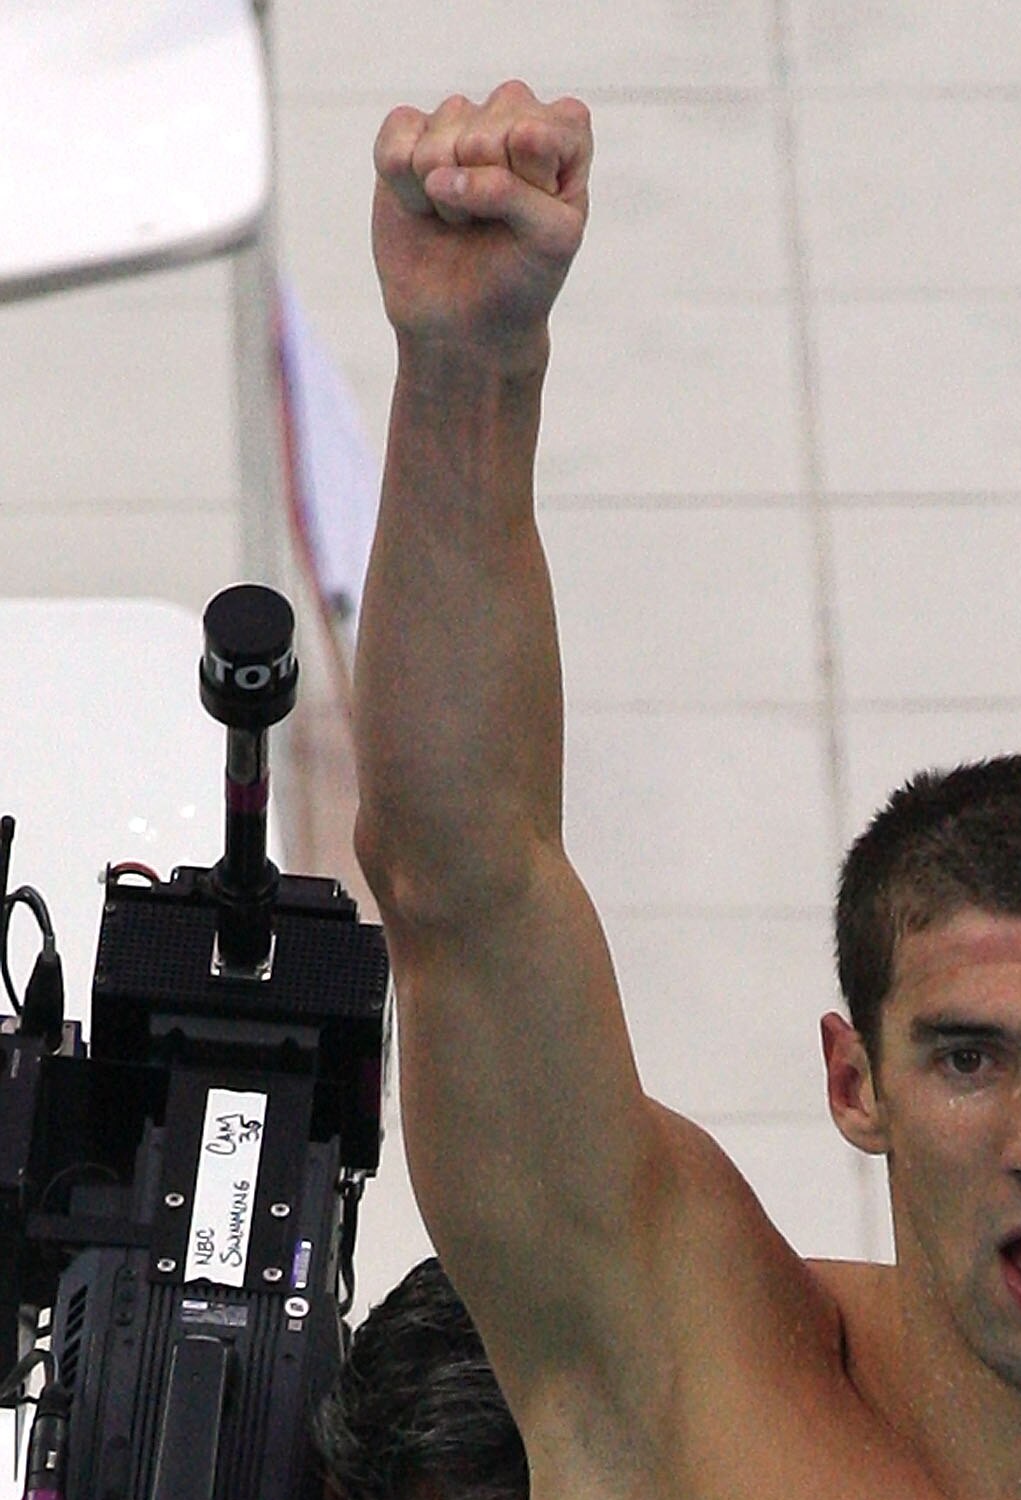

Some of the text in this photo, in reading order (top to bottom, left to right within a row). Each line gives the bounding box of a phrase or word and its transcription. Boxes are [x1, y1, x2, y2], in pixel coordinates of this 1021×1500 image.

[205, 1113, 240, 1155] CAM
[219, 1180, 250, 1267] SWIMMING
[195, 1228, 215, 1265] NBC
